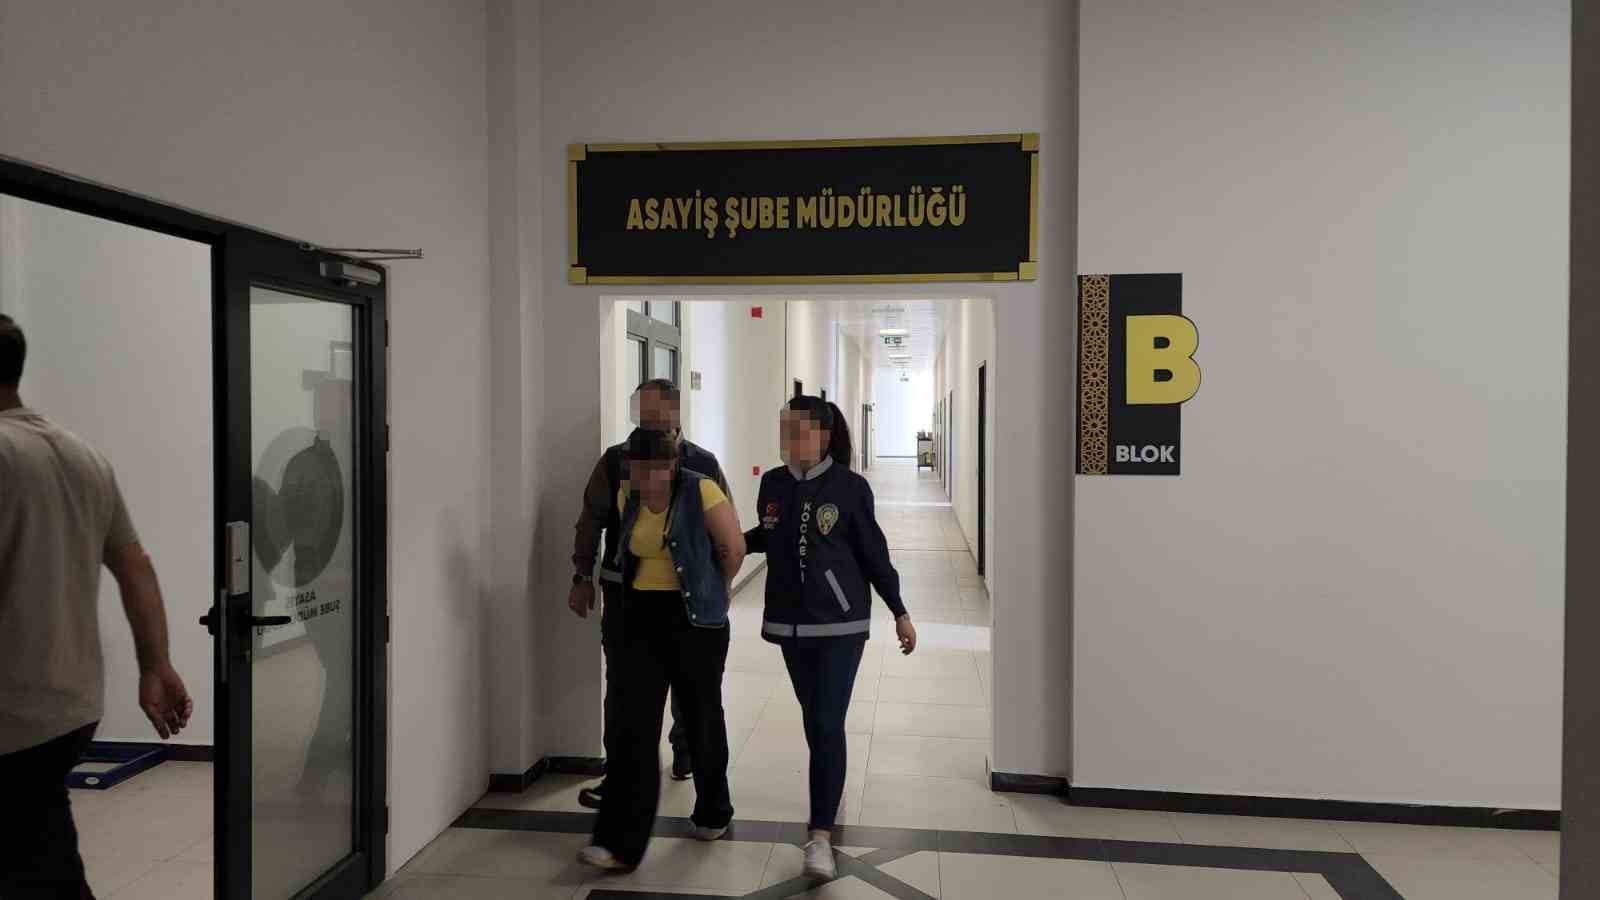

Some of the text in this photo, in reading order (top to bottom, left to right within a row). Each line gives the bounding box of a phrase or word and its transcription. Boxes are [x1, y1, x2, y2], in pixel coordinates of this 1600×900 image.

[626, 185, 966, 239] ASAYİŞ ŞUBE MÜDÜRLÜĞÜ
[1125, 314, 1201, 405] B
[1115, 444, 1176, 463] BLOK
